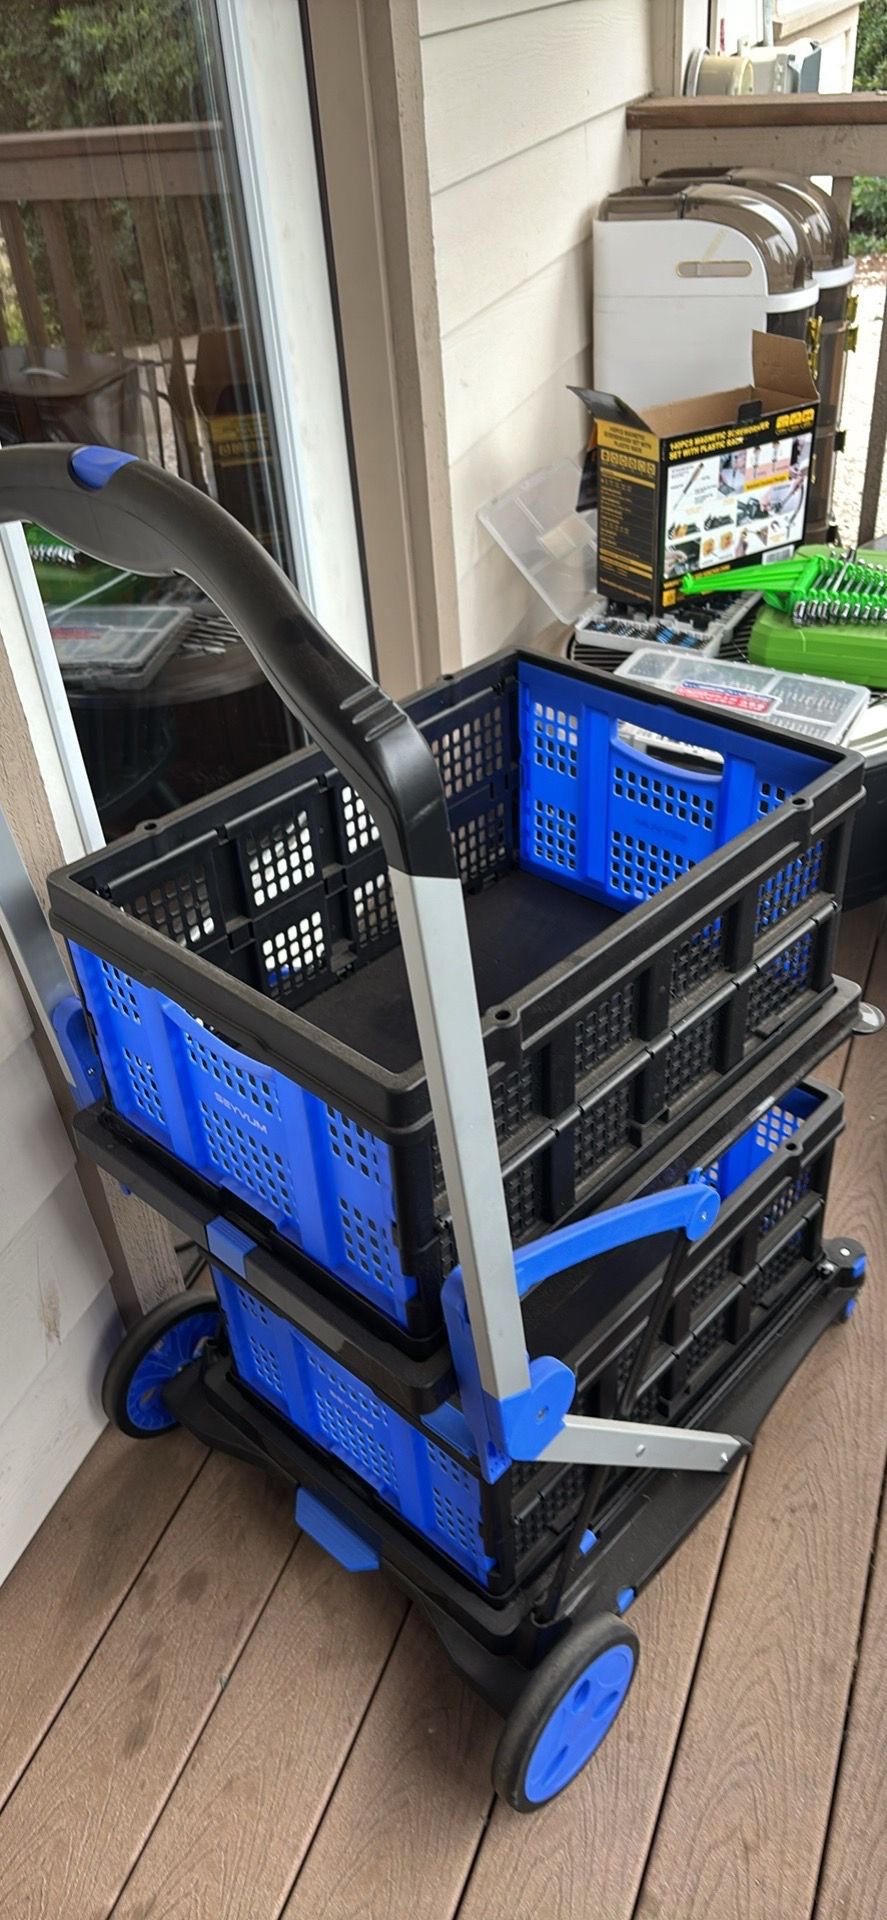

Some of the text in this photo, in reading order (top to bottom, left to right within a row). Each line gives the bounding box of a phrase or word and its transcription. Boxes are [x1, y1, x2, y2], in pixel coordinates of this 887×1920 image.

[669, 450, 683, 461] SET
[683, 446, 700, 457] WITH
[700, 440, 726, 453] PLASTIC
[213, 1091, 268, 1135] SEYVUM
